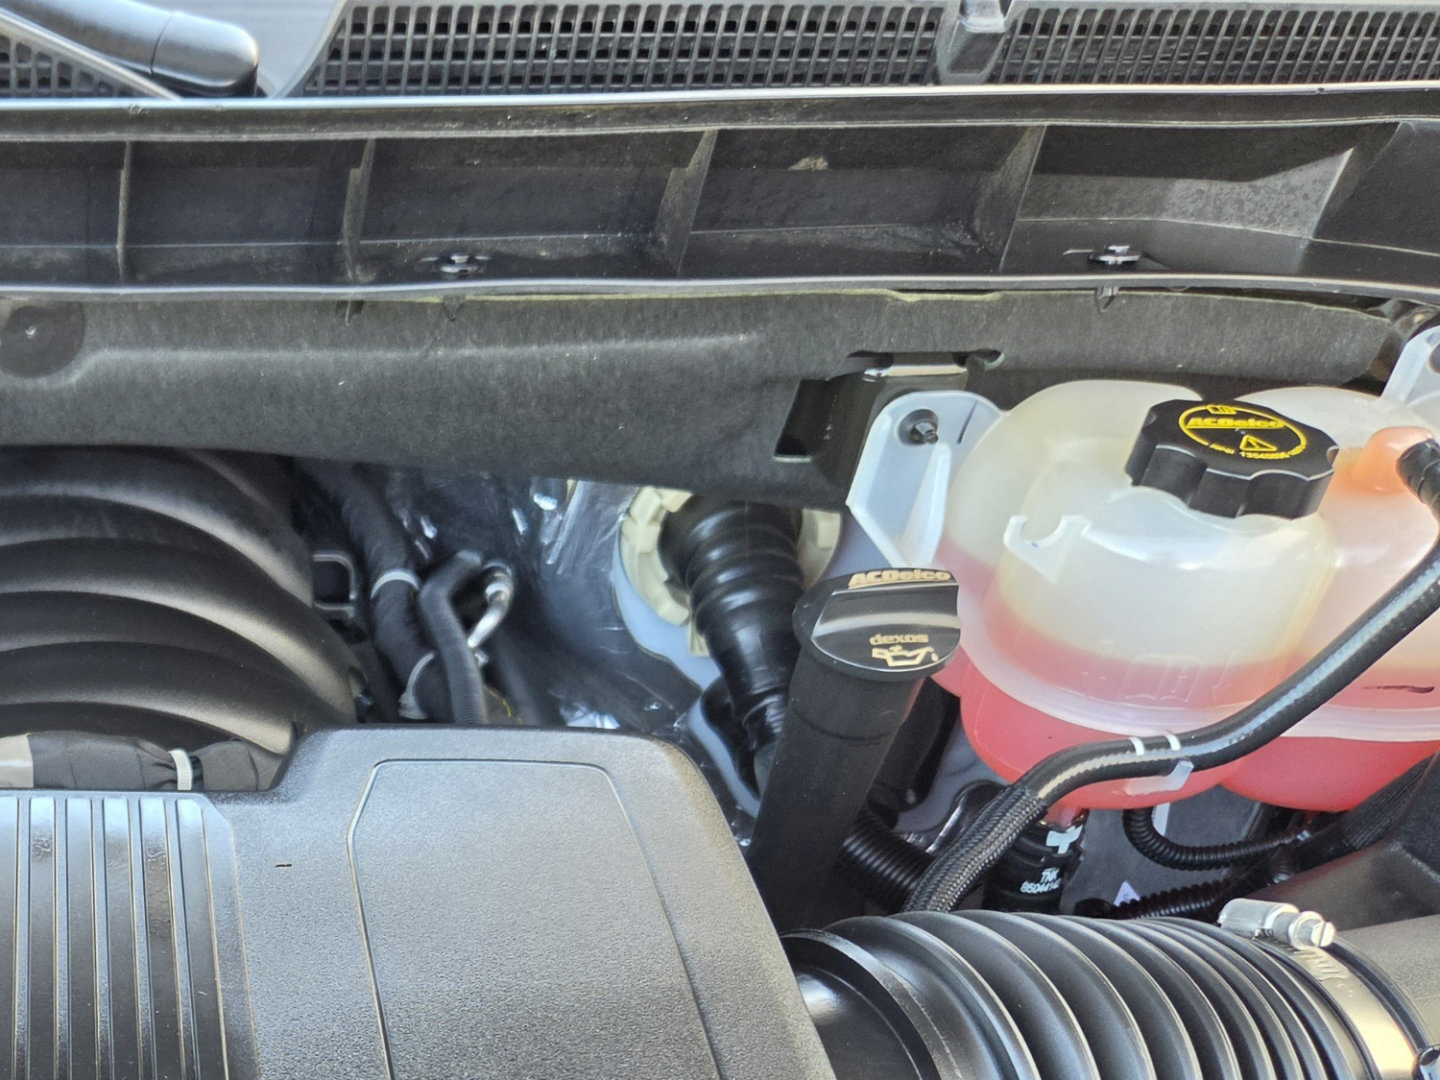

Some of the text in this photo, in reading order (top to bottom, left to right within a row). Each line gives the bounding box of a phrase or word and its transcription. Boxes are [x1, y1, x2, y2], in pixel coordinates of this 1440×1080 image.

[1186, 417, 1286, 429] ACDelco
[848, 569, 951, 589] ACDelco
[868, 633, 929, 646] dexos
